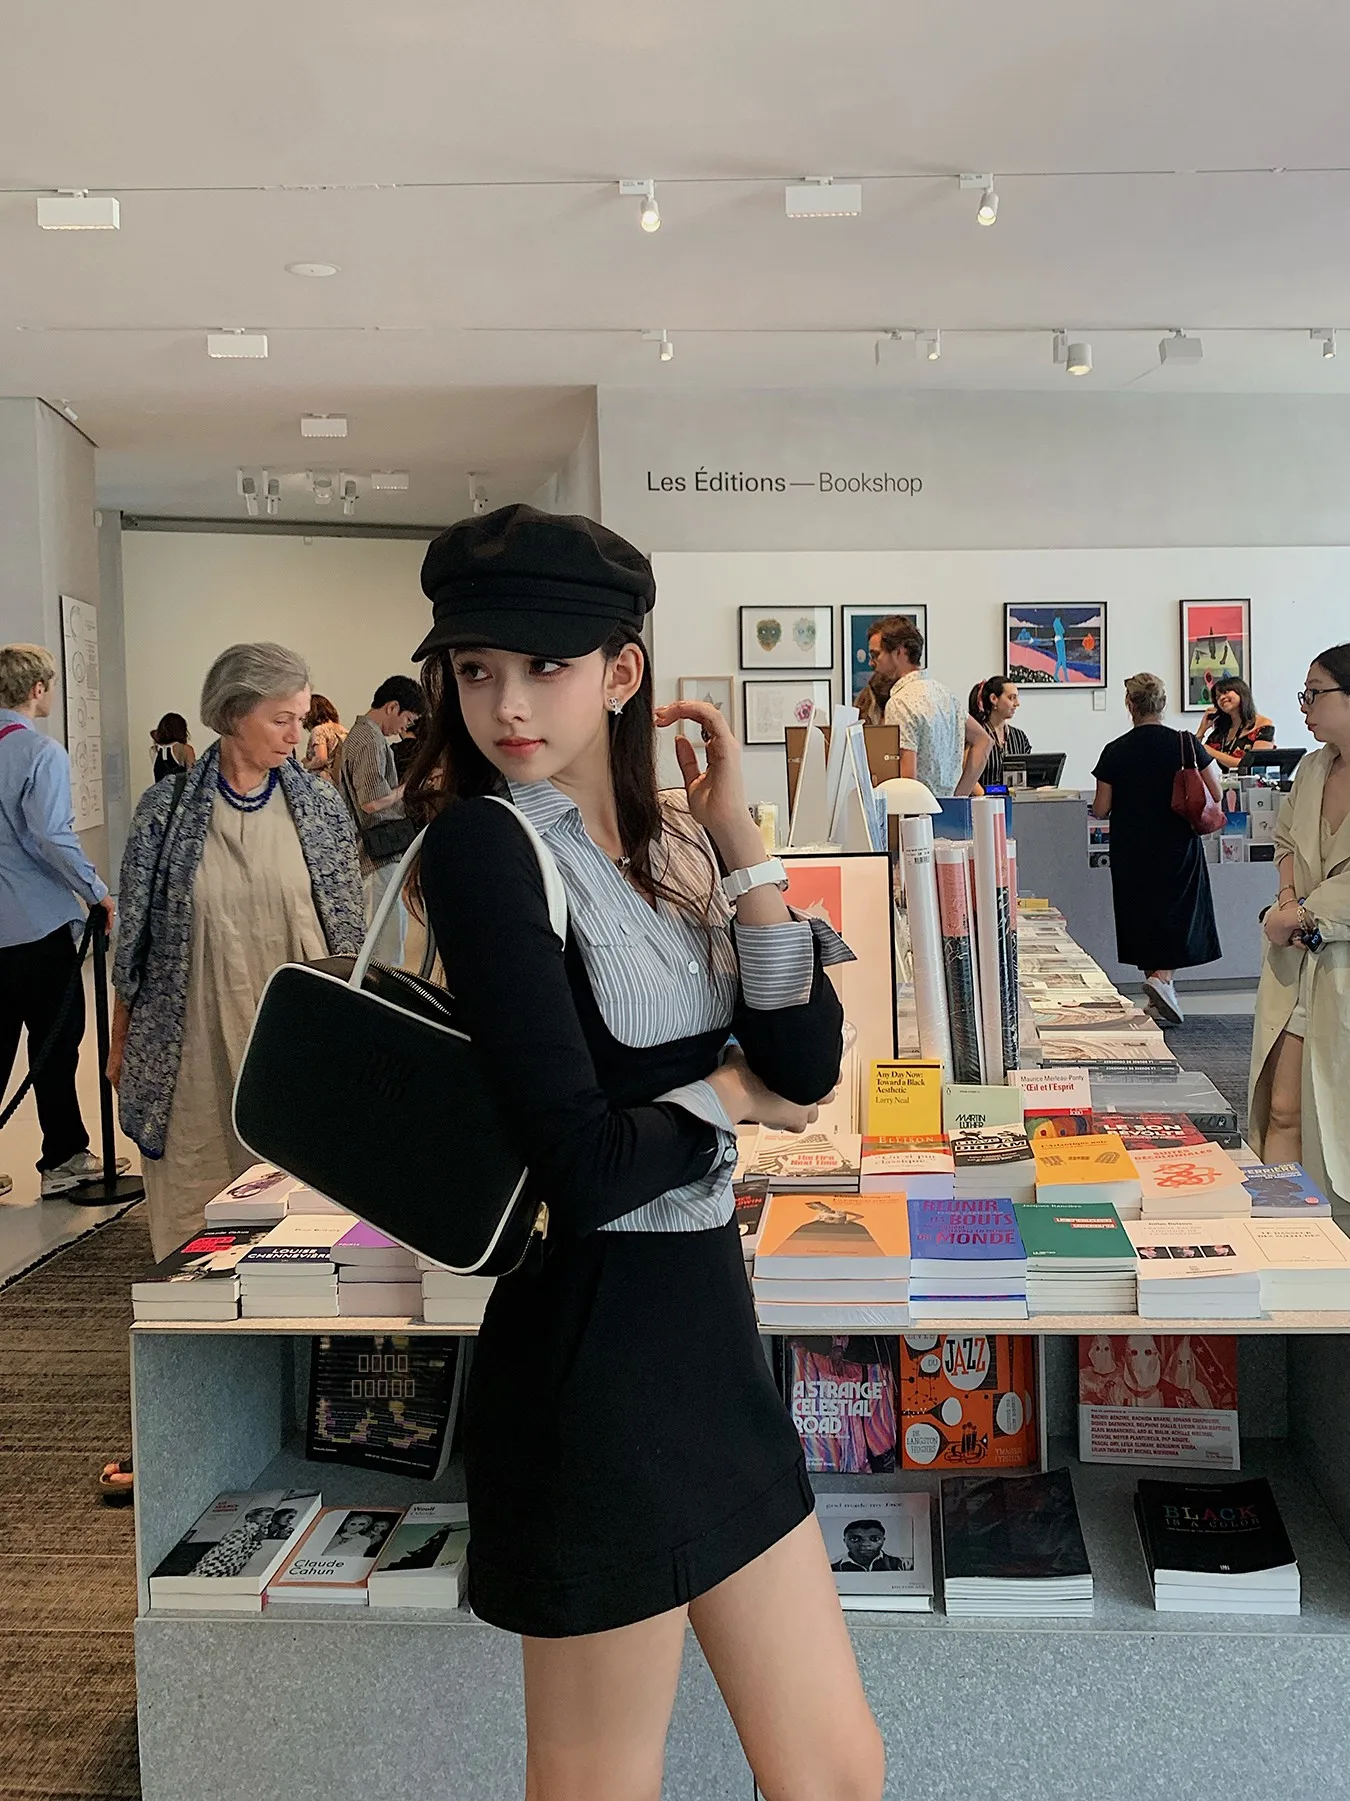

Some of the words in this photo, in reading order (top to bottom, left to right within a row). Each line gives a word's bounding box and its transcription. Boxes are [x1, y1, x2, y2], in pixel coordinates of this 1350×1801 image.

[647, 471, 686, 492] Les
[876, 1071, 890, 1079] Any
[891, 1071, 904, 1079] Day
[906, 1070, 923, 1078] Now:
[877, 1078, 902, 1086] Toward
[875, 1096, 892, 1105] Larry
[895, 1096, 910, 1104] Neal
[955, 1114, 986, 1122] MARTIN
[959, 1121, 984, 1129] LUTHER
[954, 1139, 1027, 1152] DREAM
[949, 1213, 1013, 1226] BOUTS
[935, 1232, 1016, 1245] MONDE
[927, 1359, 938, 1367] DU
[945, 1337, 986, 1377] JAZZ
[792, 1381, 804, 1398] A
[806, 1380, 882, 1400] STRANGE
[792, 1398, 872, 1417] CELESTIAL
[792, 1416, 843, 1434] ROAD
[1162, 1504, 1258, 1521] BLACK
[1209, 1518, 1260, 1529] COLOR
[292, 1559, 345, 1569] Claude
[288, 1567, 335, 1576] Cahun
